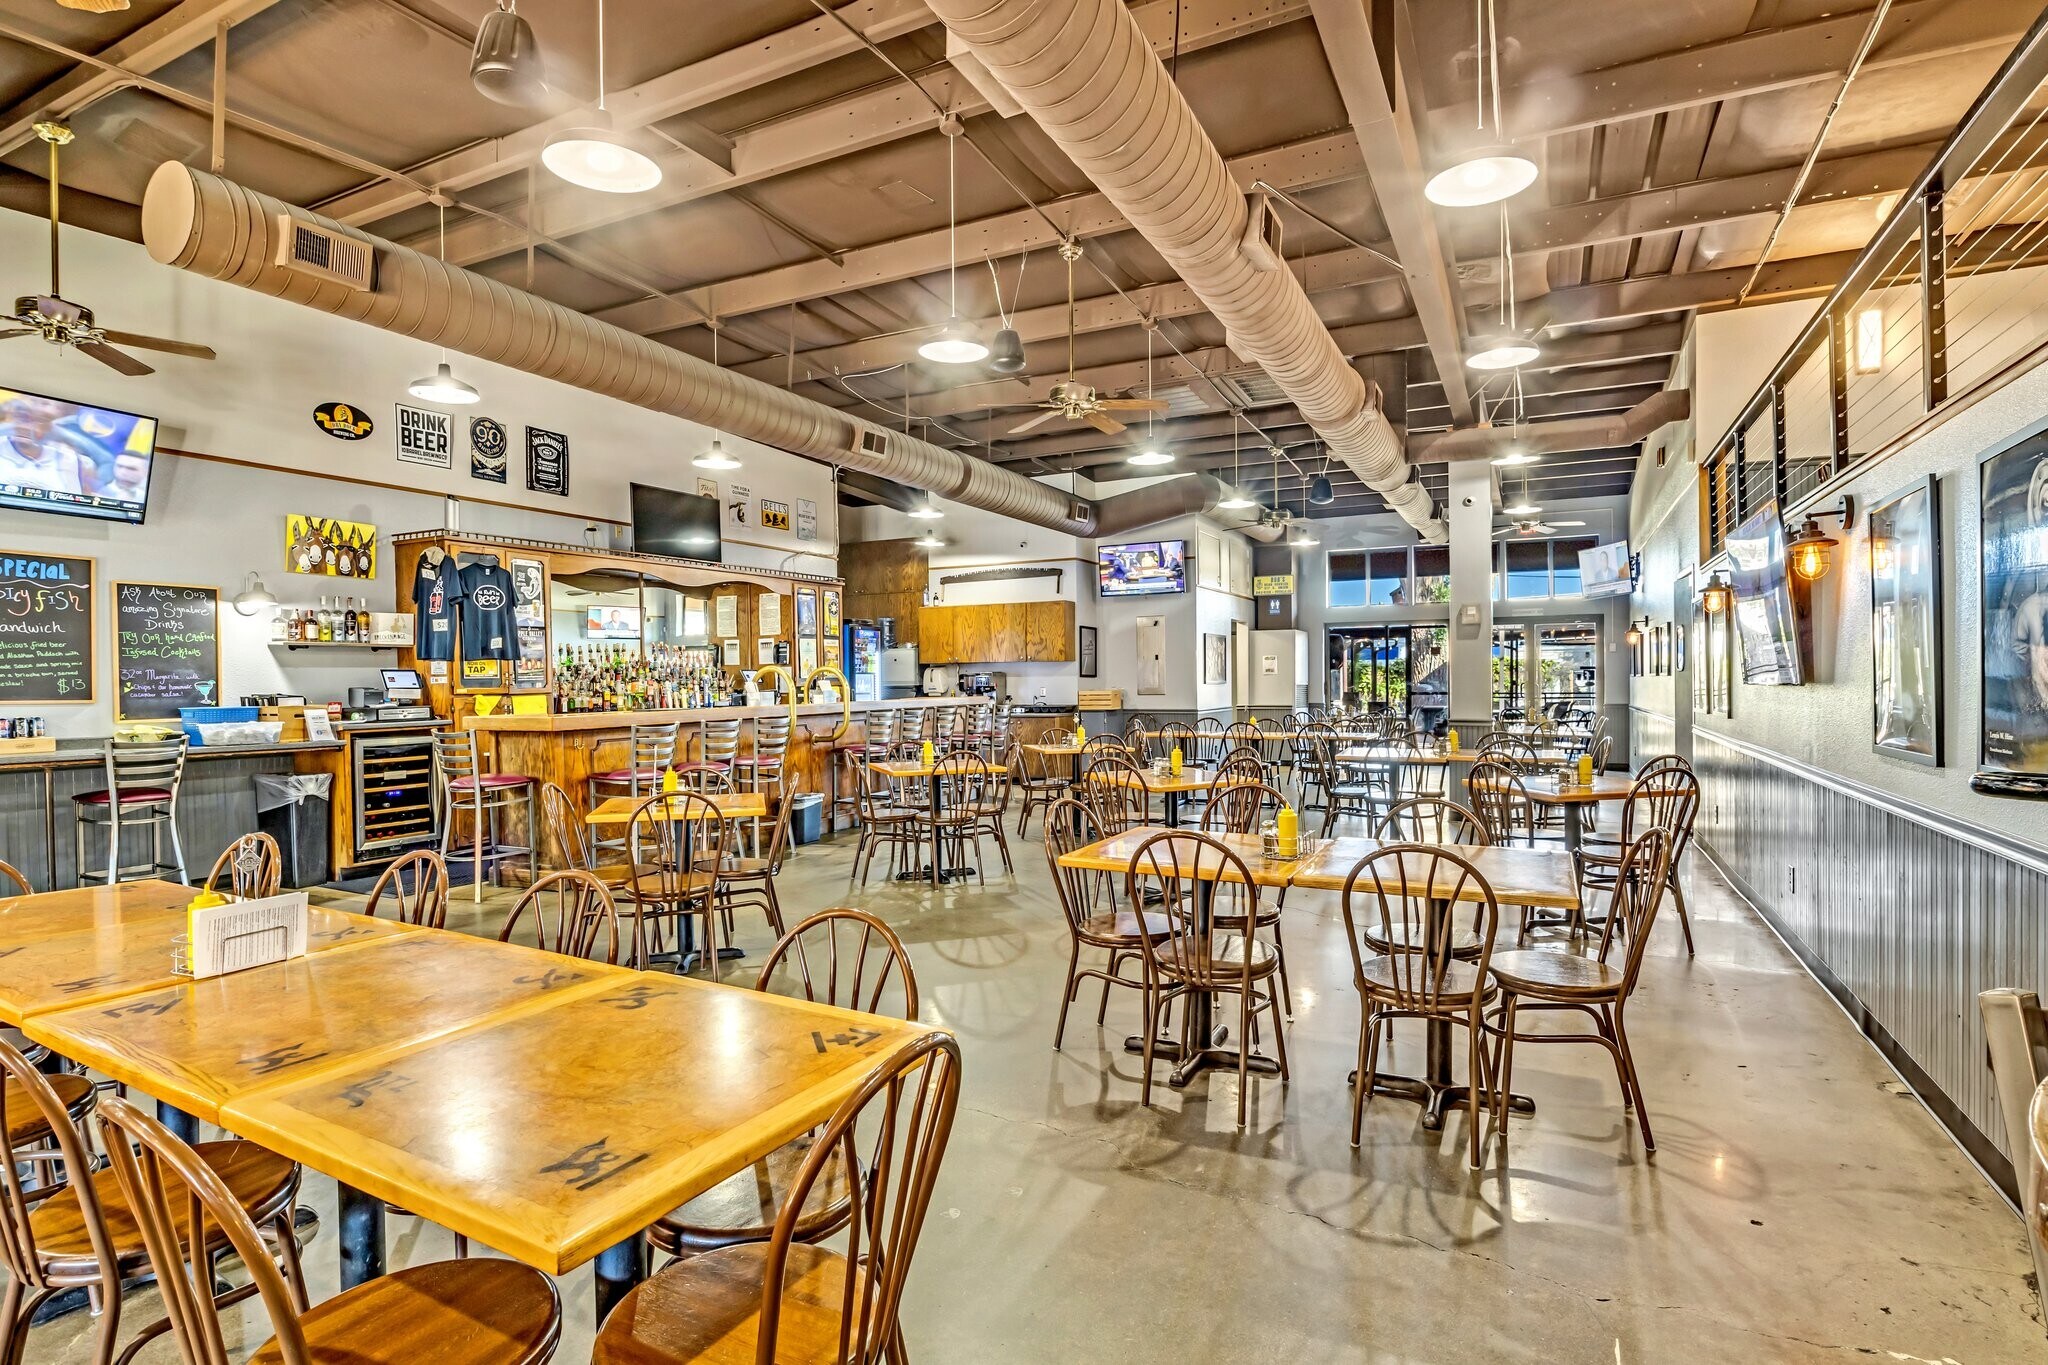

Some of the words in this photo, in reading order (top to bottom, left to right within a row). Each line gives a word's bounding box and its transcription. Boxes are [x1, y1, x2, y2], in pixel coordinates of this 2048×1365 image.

[400, 409, 447, 434] DRINK
[401, 426, 447, 453] BEER
[475, 425, 500, 445] 90
[532, 436, 545, 446] JACK
[144, 619, 185, 632] Drinks
